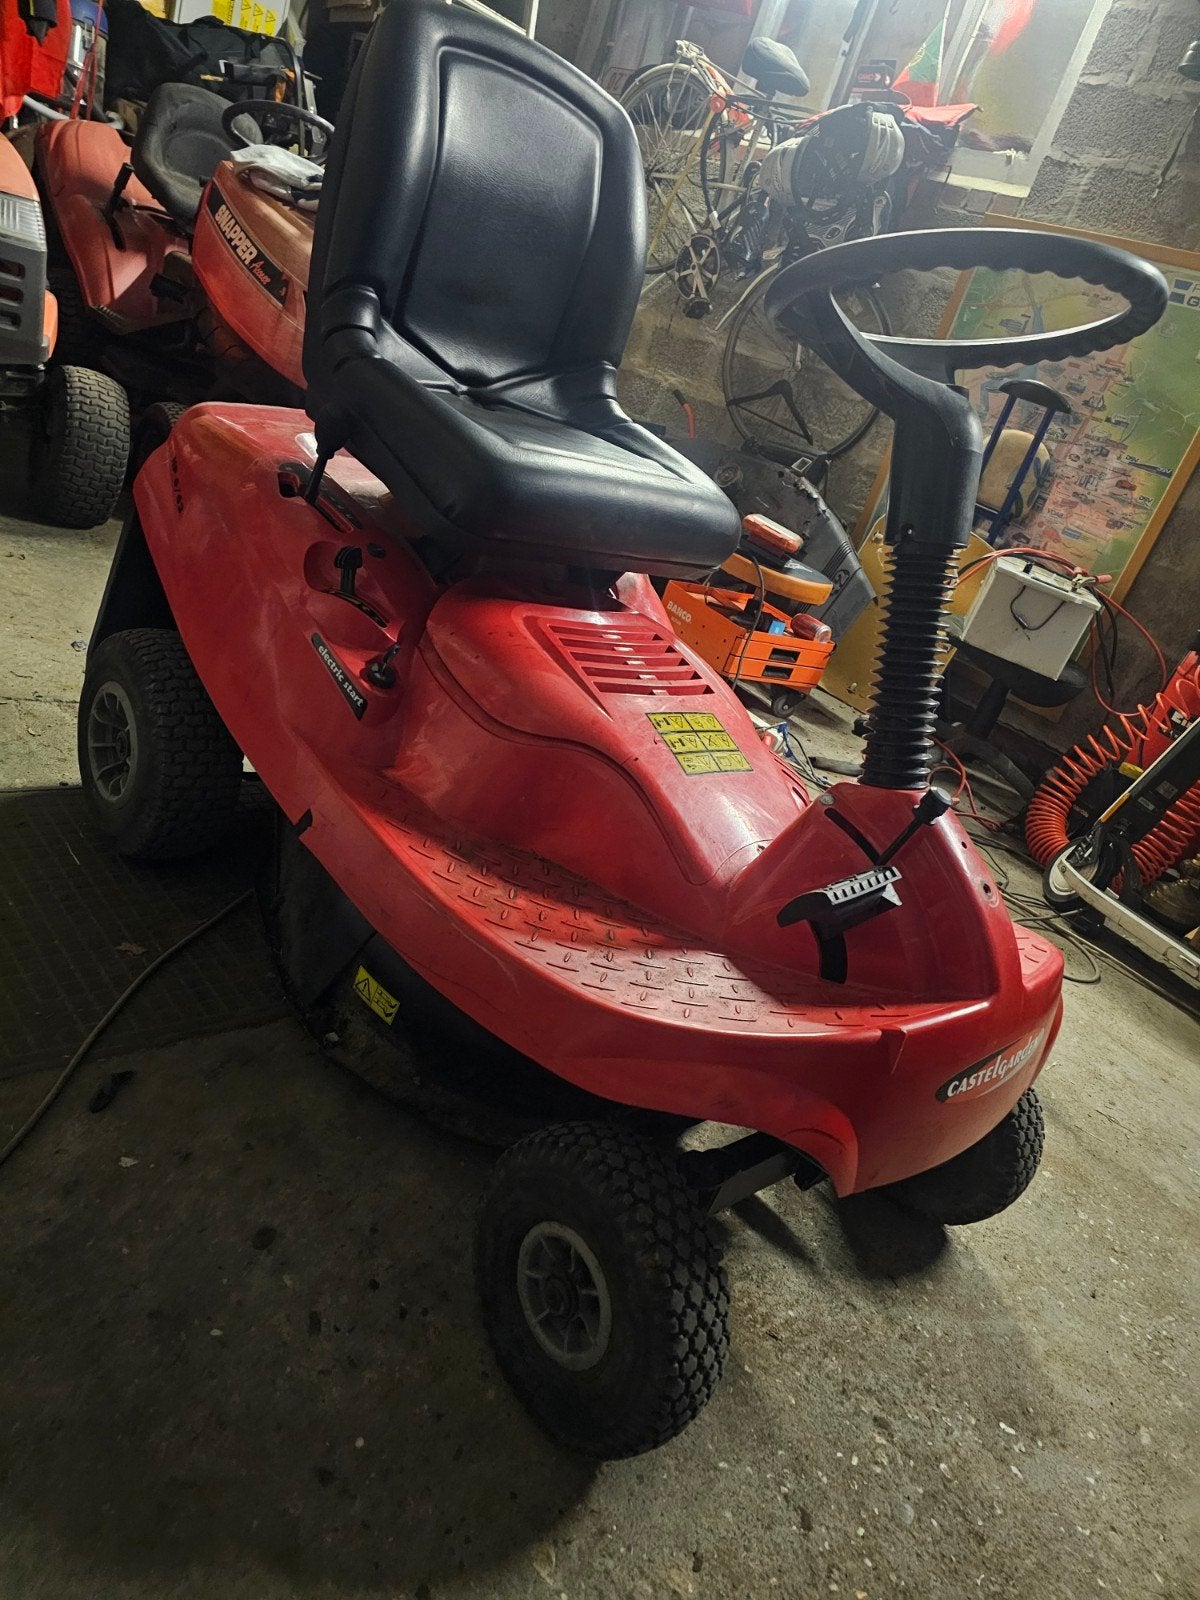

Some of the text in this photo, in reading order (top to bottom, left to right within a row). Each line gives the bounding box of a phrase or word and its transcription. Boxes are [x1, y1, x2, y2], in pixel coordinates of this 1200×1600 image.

[215, 203, 258, 265] SNAPPER
[667, 600, 692, 623] BAHCO
[318, 645, 363, 707] electric start
